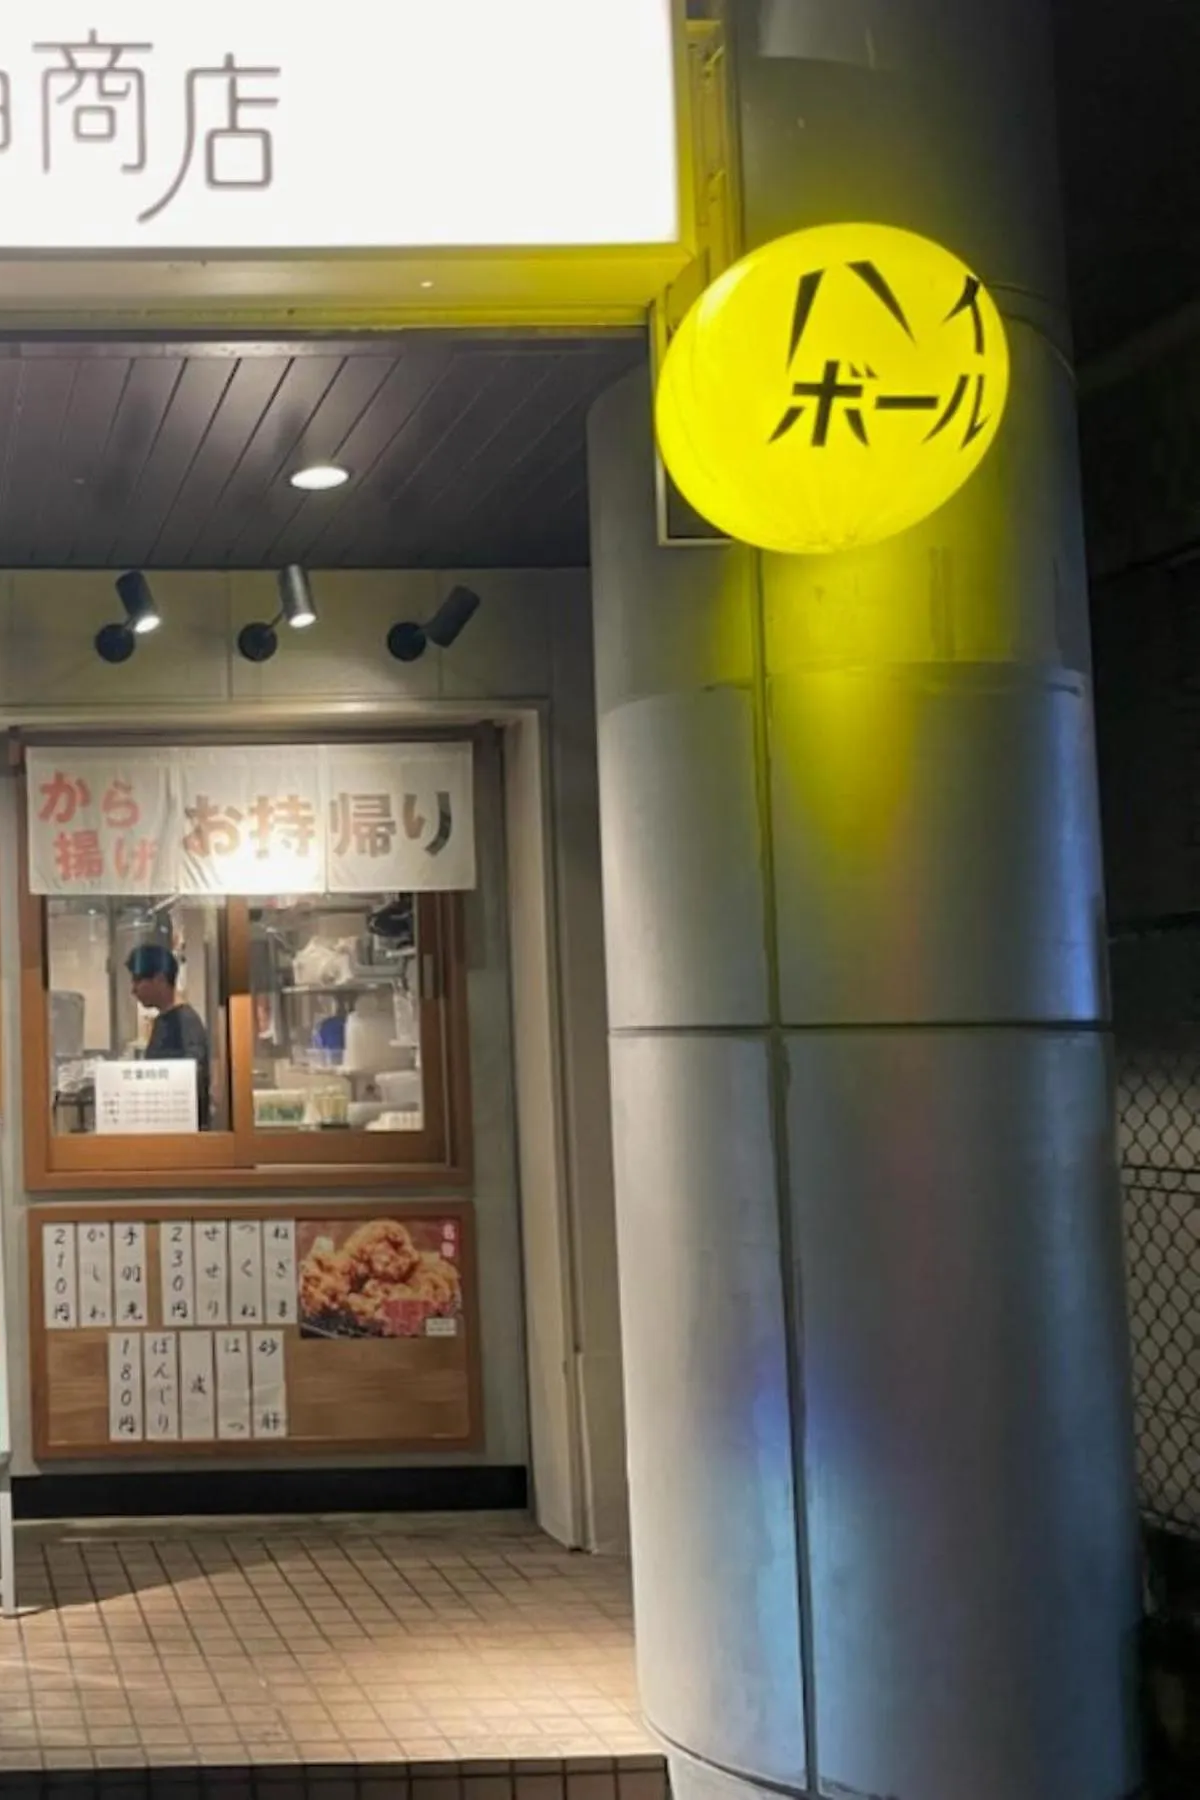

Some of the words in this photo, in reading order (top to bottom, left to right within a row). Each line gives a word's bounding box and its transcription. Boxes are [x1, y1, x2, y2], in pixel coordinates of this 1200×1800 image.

[787, 260, 985, 373] ハイ
[767, 360, 991, 450] ボール
[38, 770, 141, 830] から
[183, 791, 452, 858] お持帰り
[54, 830, 157, 883] 揚げ
